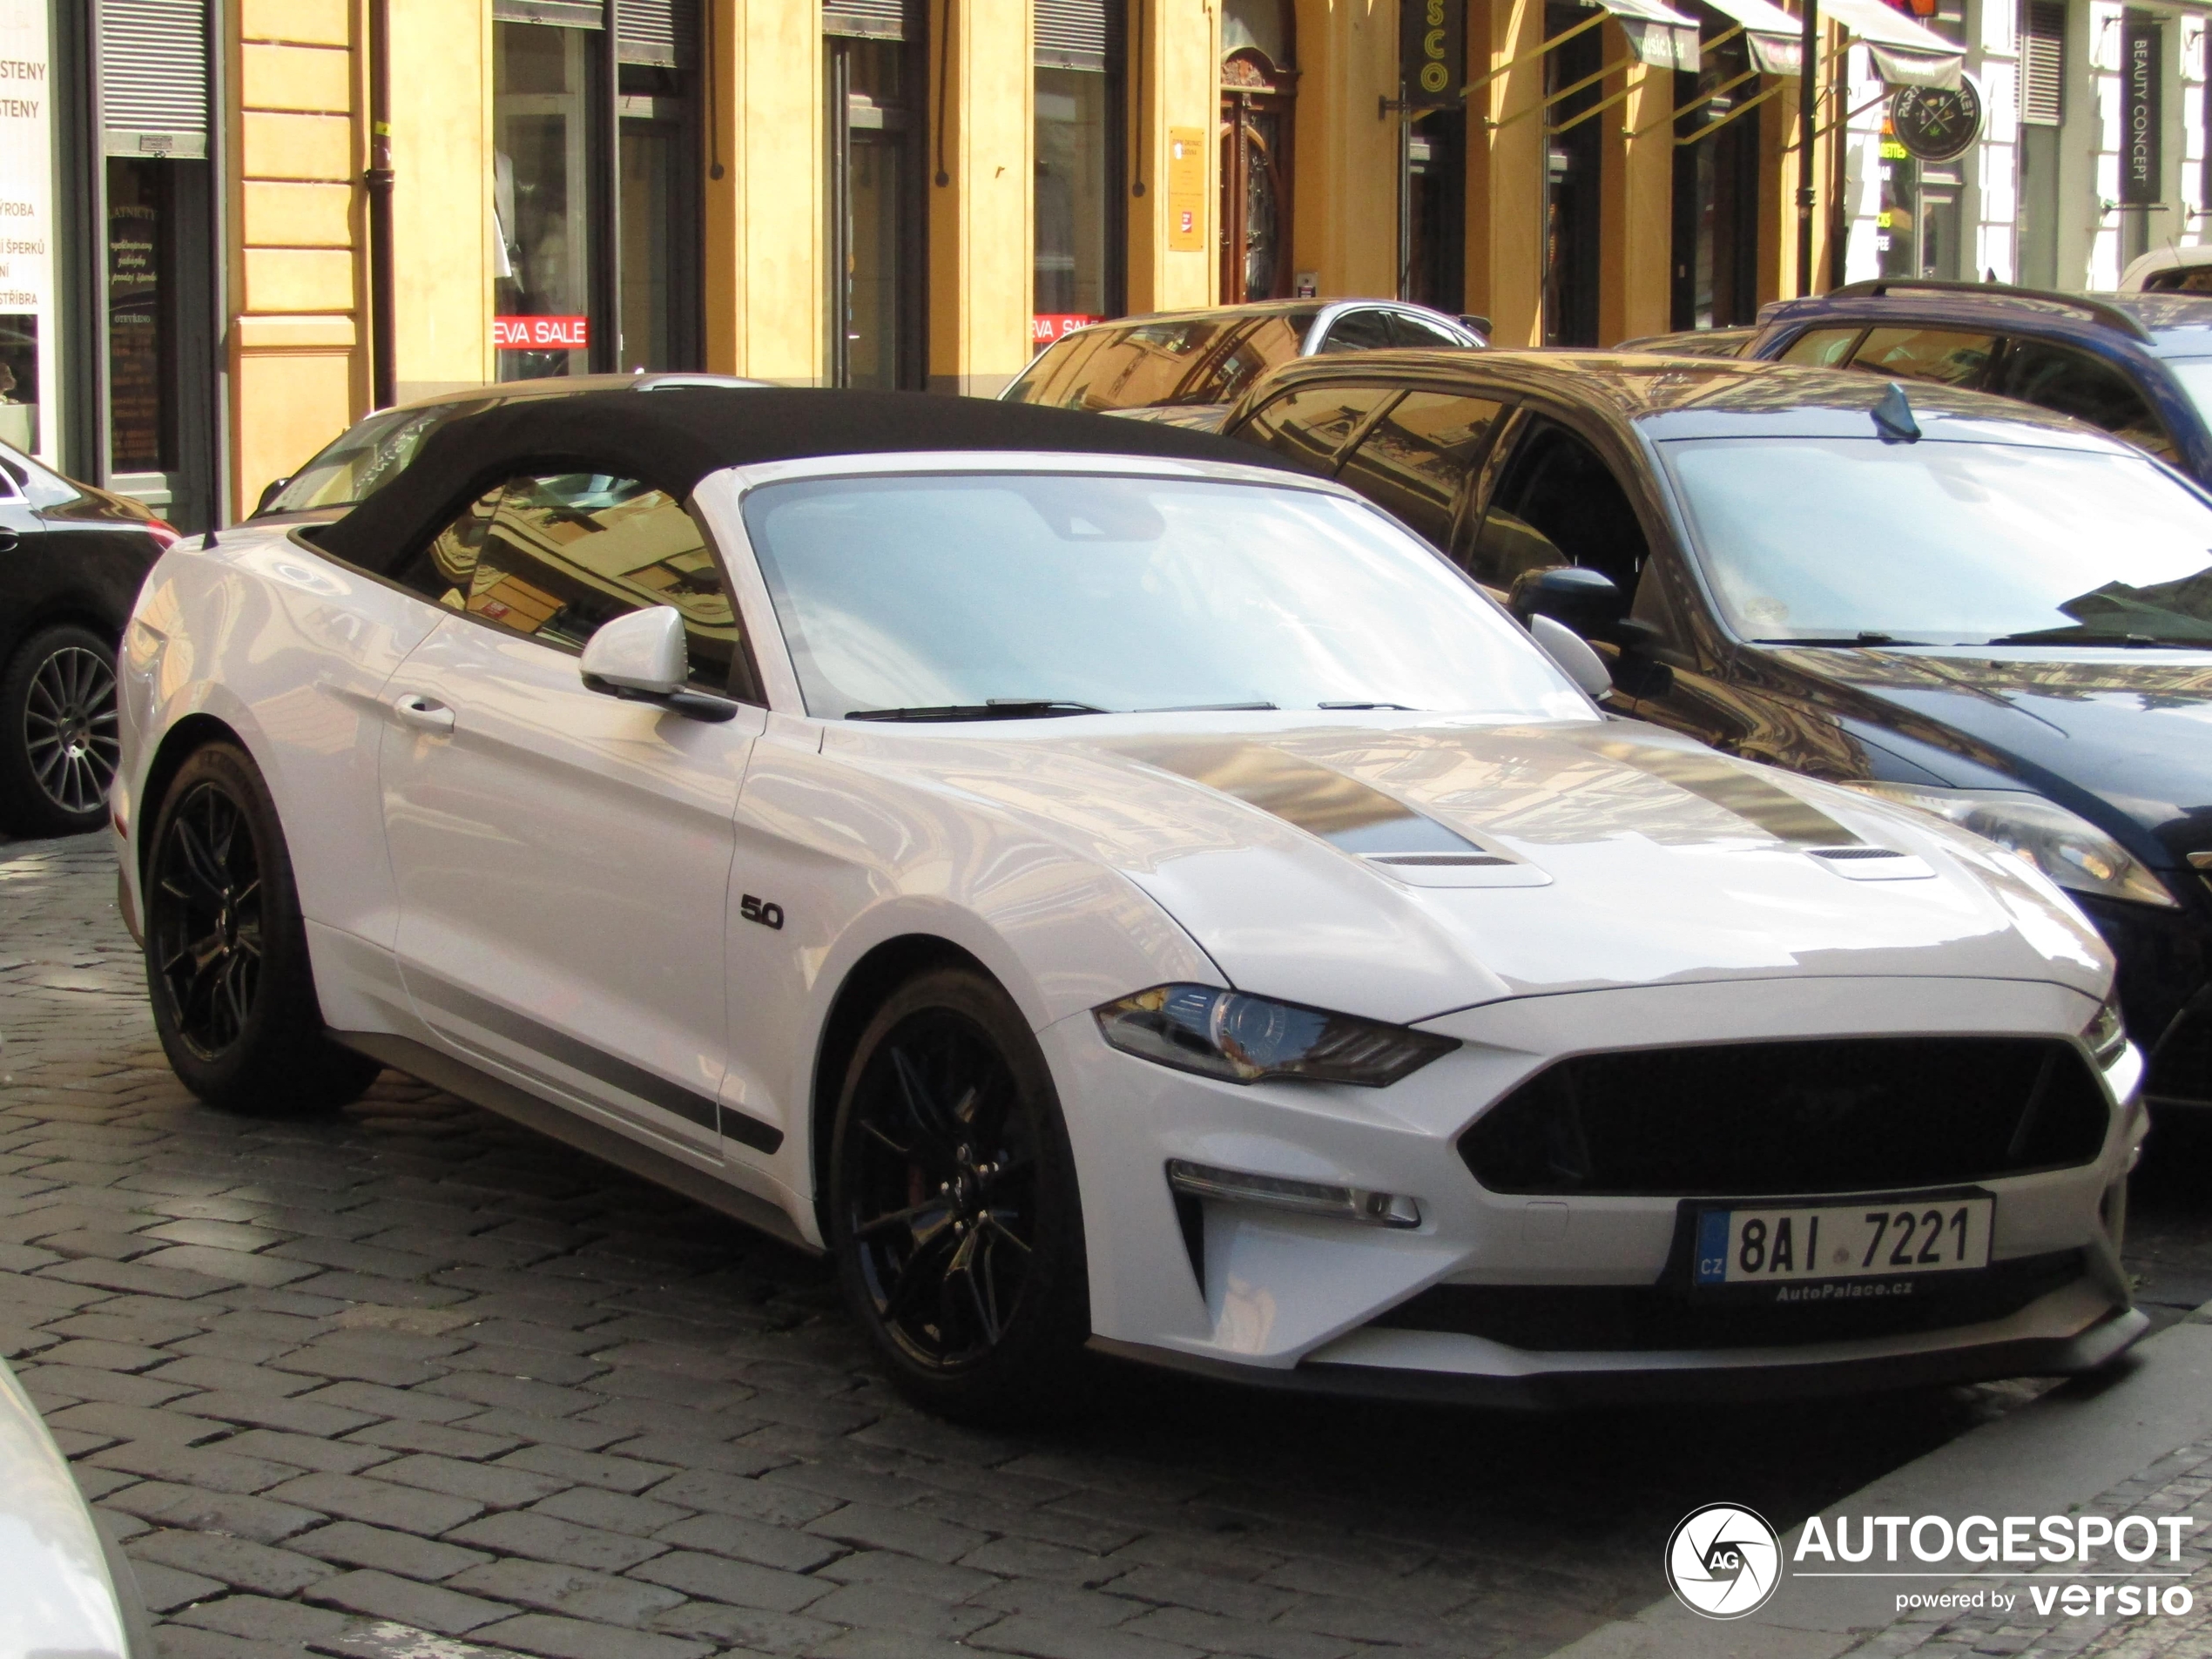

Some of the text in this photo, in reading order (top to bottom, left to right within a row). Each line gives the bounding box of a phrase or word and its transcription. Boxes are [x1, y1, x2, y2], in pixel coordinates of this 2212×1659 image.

[0, 60, 46, 80] STENY
[0, 99, 39, 118] TENY
[2133, 40, 2148, 181] BEAUTY CONCEPT
[6, 238, 45, 255] ŠPERKŮ
[535, 321, 586, 343] SALE
[1739, 1206, 1969, 1274] 8AI 7221
[1700, 1258, 1723, 1275] CZ
[1776, 1281, 1913, 1302] AutoPalace.cz
